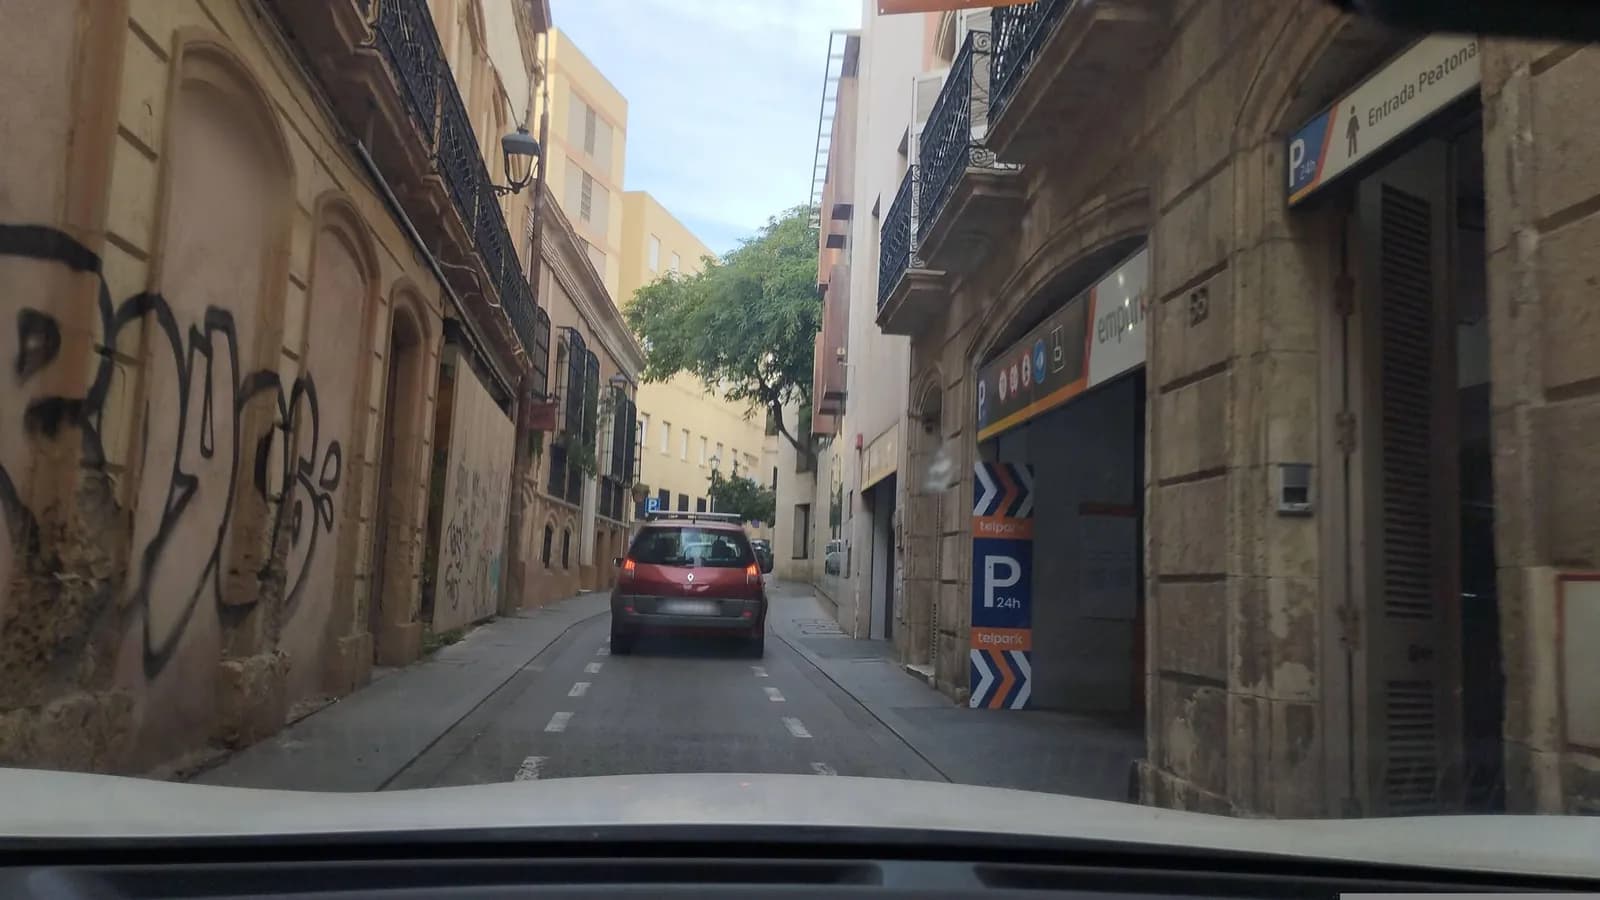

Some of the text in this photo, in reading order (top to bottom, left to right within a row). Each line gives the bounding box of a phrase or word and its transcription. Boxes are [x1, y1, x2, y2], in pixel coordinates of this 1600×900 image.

[1367, 84, 1415, 127] Entrada
[1289, 138, 1305, 188] P
[978, 379, 986, 421] P
[984, 555, 1021, 609] P 24h
[977, 631, 1024, 646] telpark
